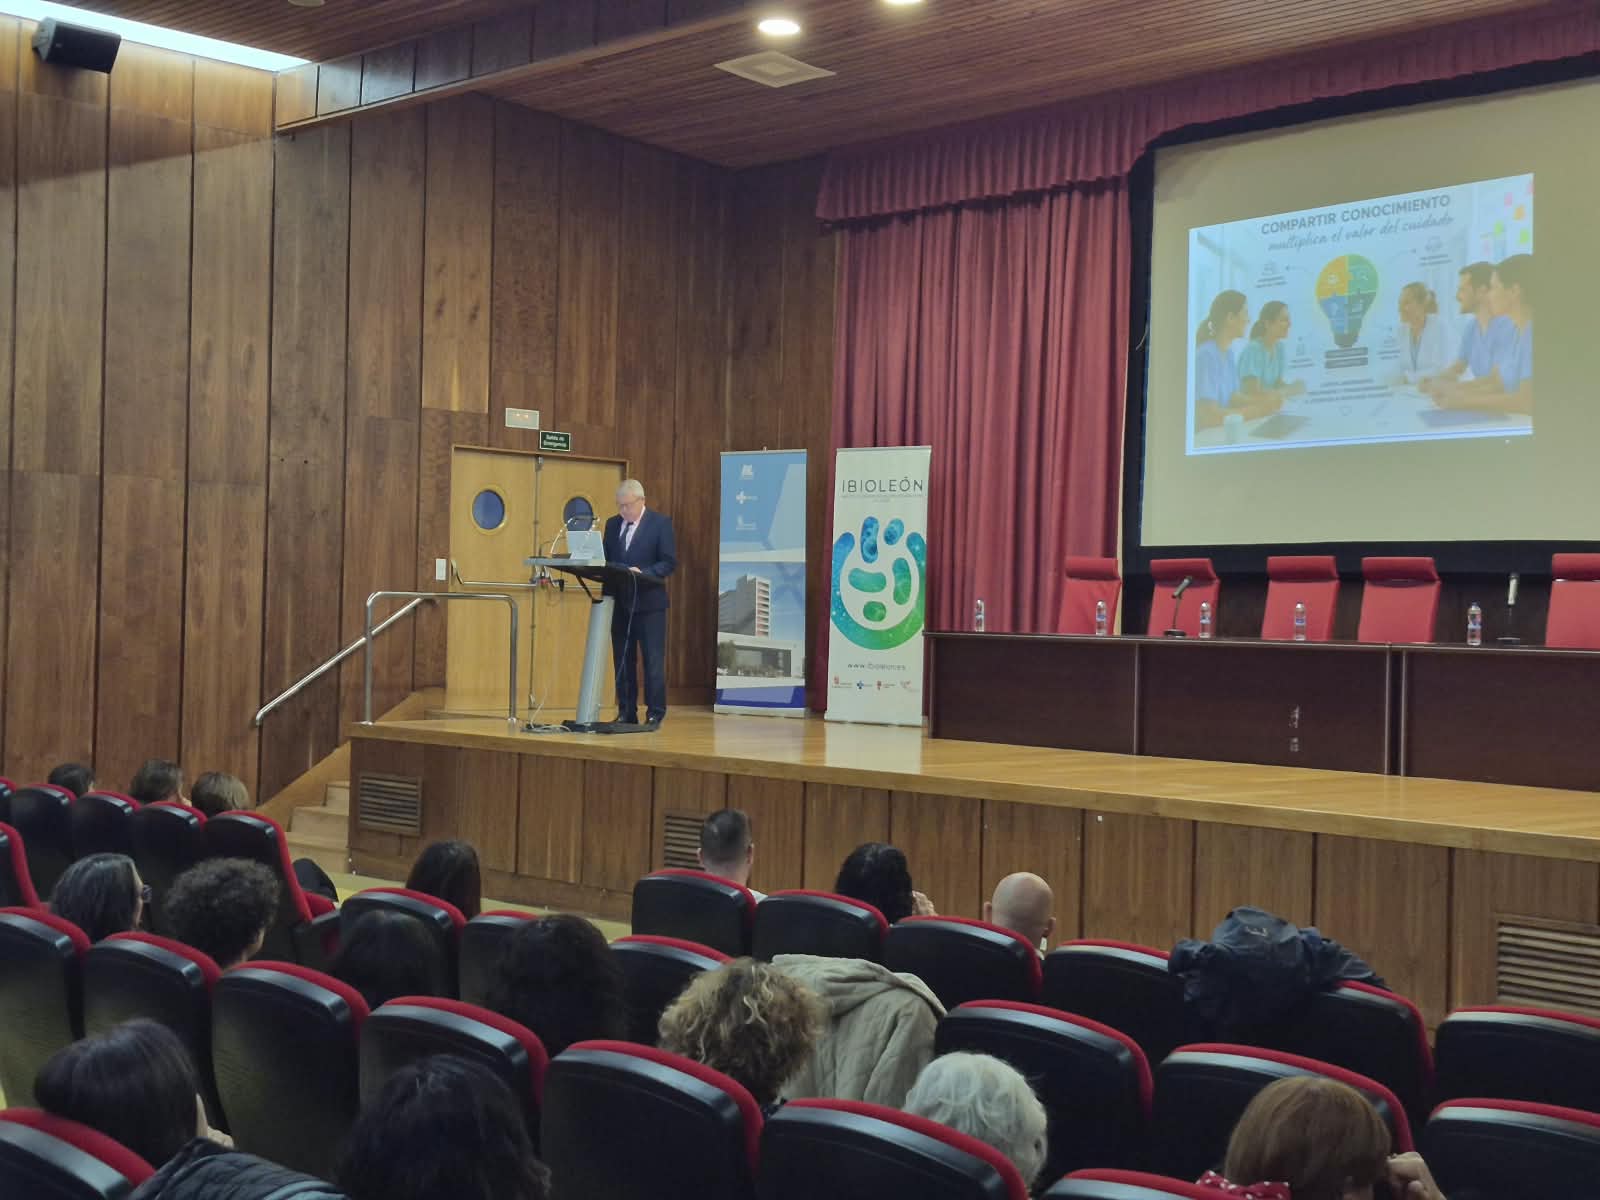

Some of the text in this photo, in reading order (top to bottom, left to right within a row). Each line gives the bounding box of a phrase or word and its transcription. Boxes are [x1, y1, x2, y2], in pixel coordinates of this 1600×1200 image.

[1261, 195, 1450, 234] COMPARTIR CONOCIMIENTO
[842, 476, 922, 492] IBIOLEÓN
